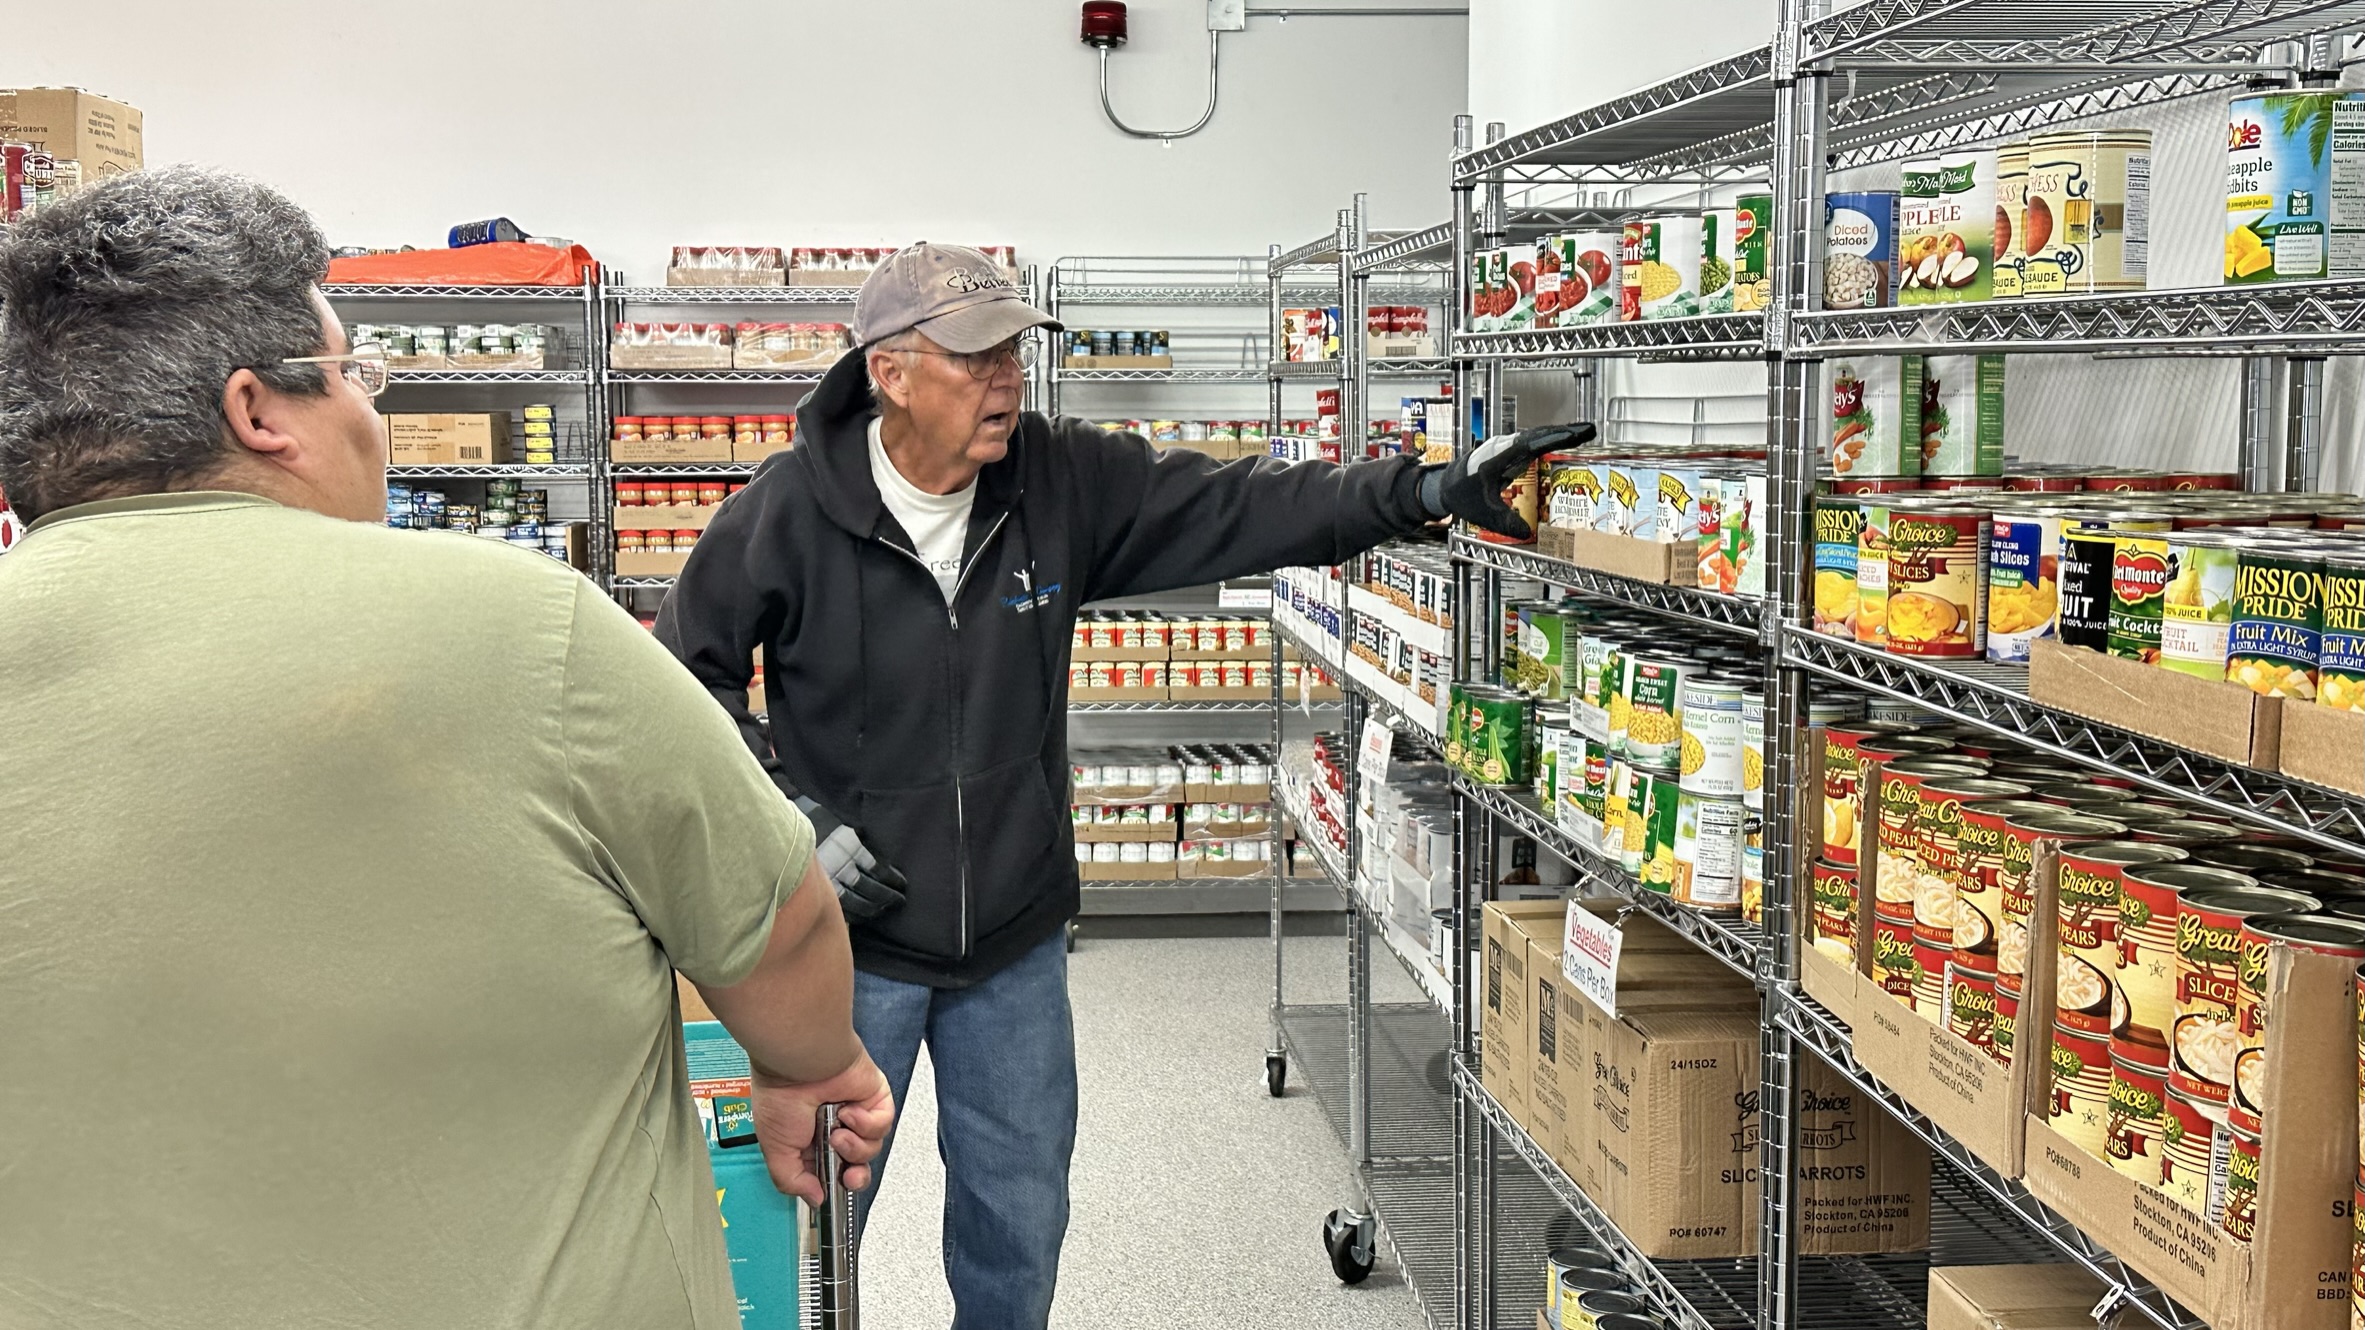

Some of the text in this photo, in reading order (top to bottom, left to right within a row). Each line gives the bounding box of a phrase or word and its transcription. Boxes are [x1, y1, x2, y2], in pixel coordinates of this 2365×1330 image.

[2335, 102, 2365, 112] Nutriti
[2292, 198, 2308, 207] NON
[2292, 207, 2307, 215] GMO
[1834, 225, 1868, 236] Diced
[1827, 236, 1868, 247] Potatoes
[1818, 528, 1852, 543] PRIDE
[1893, 518, 1946, 543] Choice
[2000, 552, 2030, 566] Slices
[1894, 565, 1930, 579] SLICES
[2125, 567, 2165, 584] Monte
[2234, 564, 2326, 608] MISSION
[2062, 595, 2094, 618] UIT
[2178, 608, 2202, 619] JUICE
[2243, 596, 2307, 620] PRIDE
[2110, 617, 2121, 627] uit
[2236, 624, 2309, 648] Fruit Mix
[2259, 643, 2285, 655] LIGHT
[2287, 645, 2317, 661] SYRUP
[2322, 637, 2346, 654] Fruit
[2339, 657, 2363, 669] LIGHT
[1639, 684, 1658, 697] Corn
[1710, 713, 1735, 724] Corn
[1889, 831, 1917, 849] PEAR
[2059, 862, 2115, 898] Choice
[1571, 912, 1612, 963] Vegetables
[2061, 926, 2097, 946] PEARS
[1563, 949, 1569, 972] 2
[1570, 954, 1586, 985] Cans
[1587, 966, 1599, 995] Per
[1887, 981, 1910, 991] DICE
[2188, 976, 2235, 1004] SLICE
[1930, 1027, 1949, 1051] Packed
[1950, 1042, 1958, 1057] for
[1670, 1058, 1718, 1070] 24/15OZ
[1929, 1044, 1954, 1072] Stockton,
[1954, 1062, 1965, 1079] CA
[1928, 1061, 1974, 1104] Product of China
[2186, 1081, 2228, 1098] NET WEIG
[723, 1103, 748, 1113] Club
[718, 1111, 754, 1124] Pampers
[1721, 1168, 1757, 1184] SLIC
[1805, 1196, 1844, 1207] Packed
[1847, 1195, 1863, 1206] for
[1804, 1211, 1857, 1222] Stockton,
[1860, 1208, 1876, 1219] CA
[1669, 1226, 1727, 1239] PO# 60747
[1804, 1222, 1894, 1235] Product of China
[2134, 1194, 2217, 1263] Stockton, CA 95206
[2133, 1216, 2206, 1278] Product of China
[2318, 1271, 2347, 1284] CAN
[2317, 1288, 2350, 1301] BBD:
